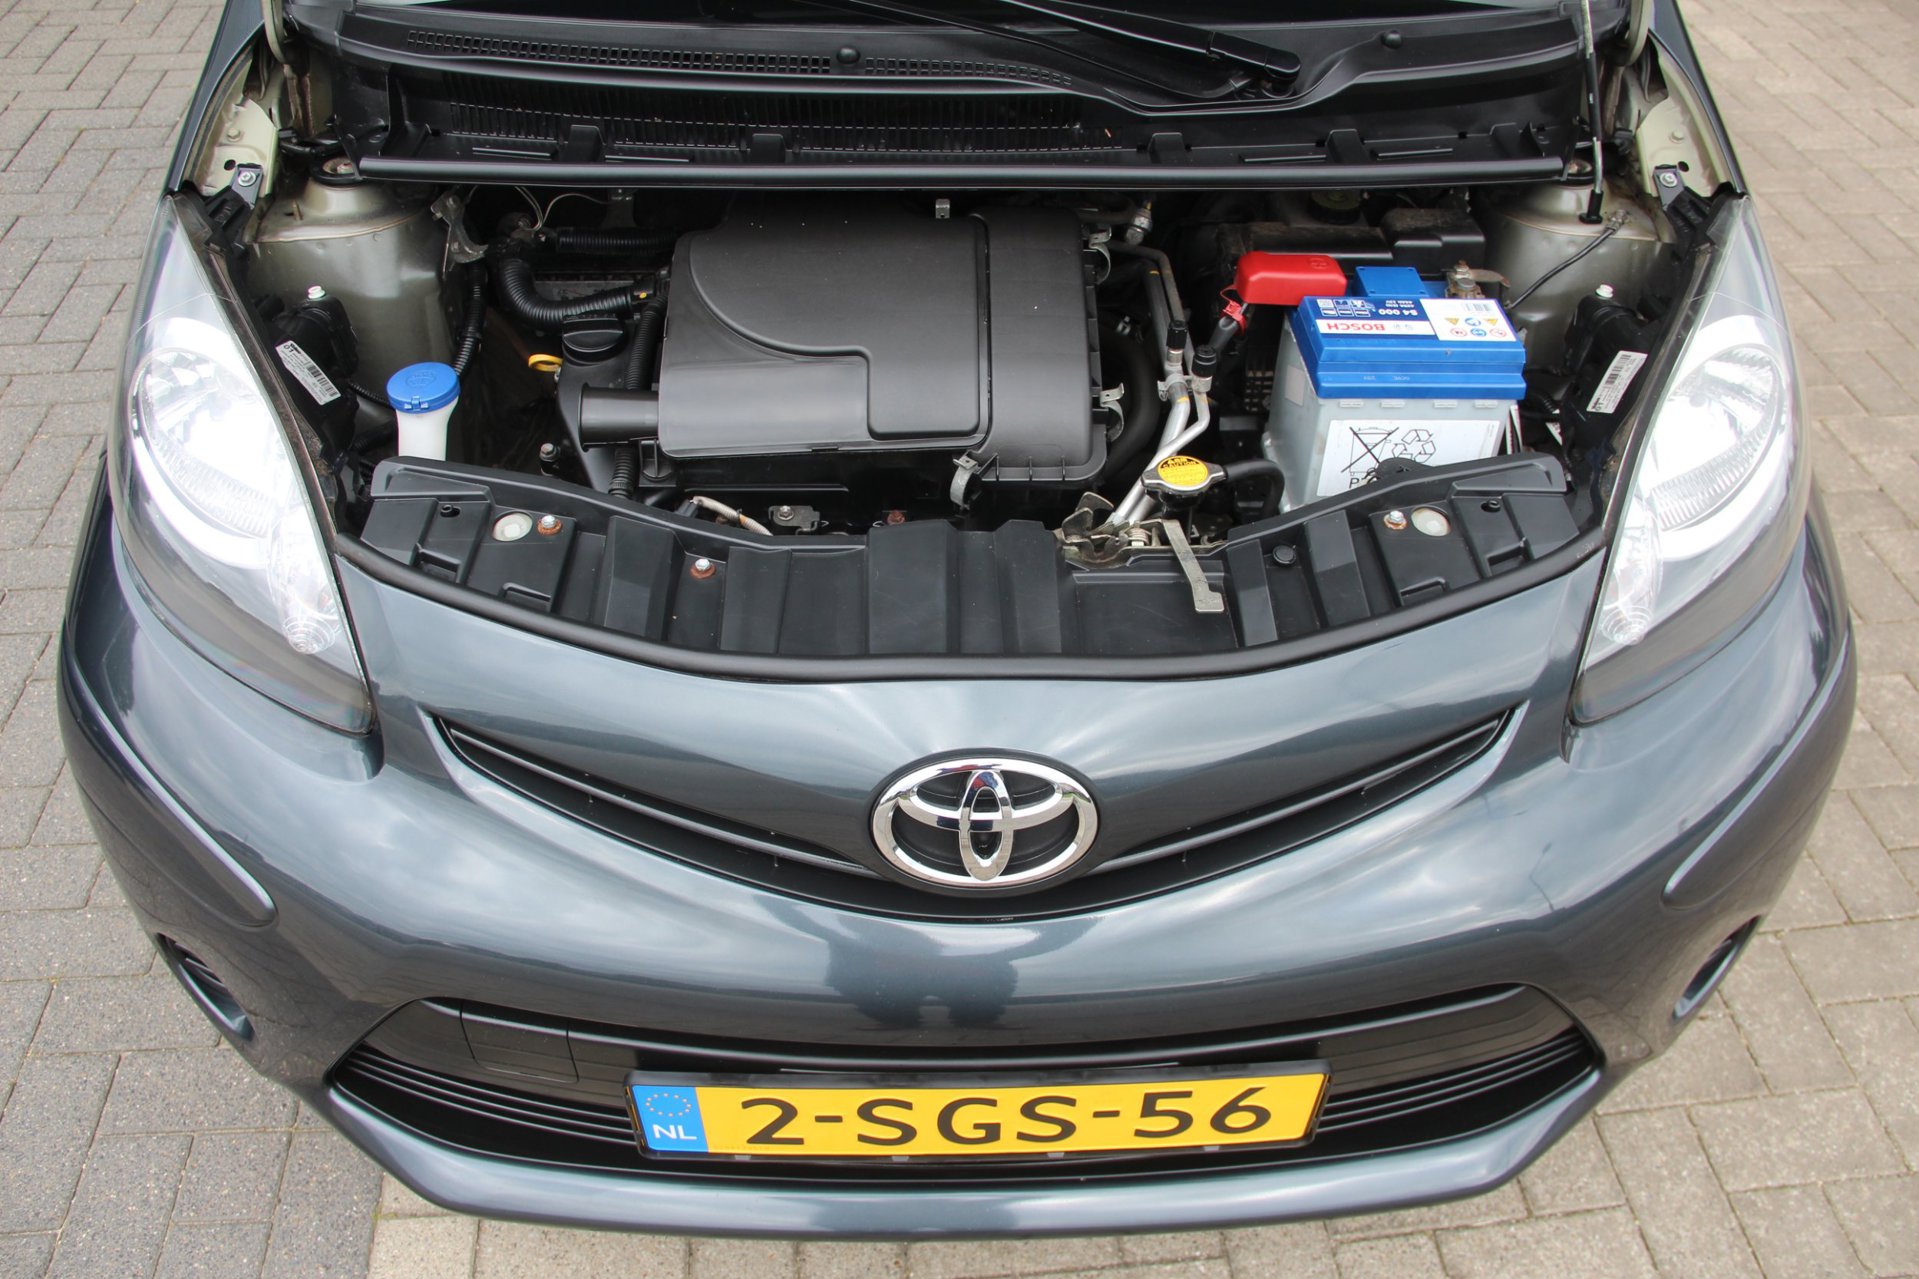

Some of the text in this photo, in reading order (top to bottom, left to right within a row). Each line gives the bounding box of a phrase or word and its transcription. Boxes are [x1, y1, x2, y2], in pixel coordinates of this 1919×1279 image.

[1327, 322, 1386, 331] BOSCH
[741, 1086, 1272, 1146] 2-SGS-56
[652, 1124, 697, 1140] NL
